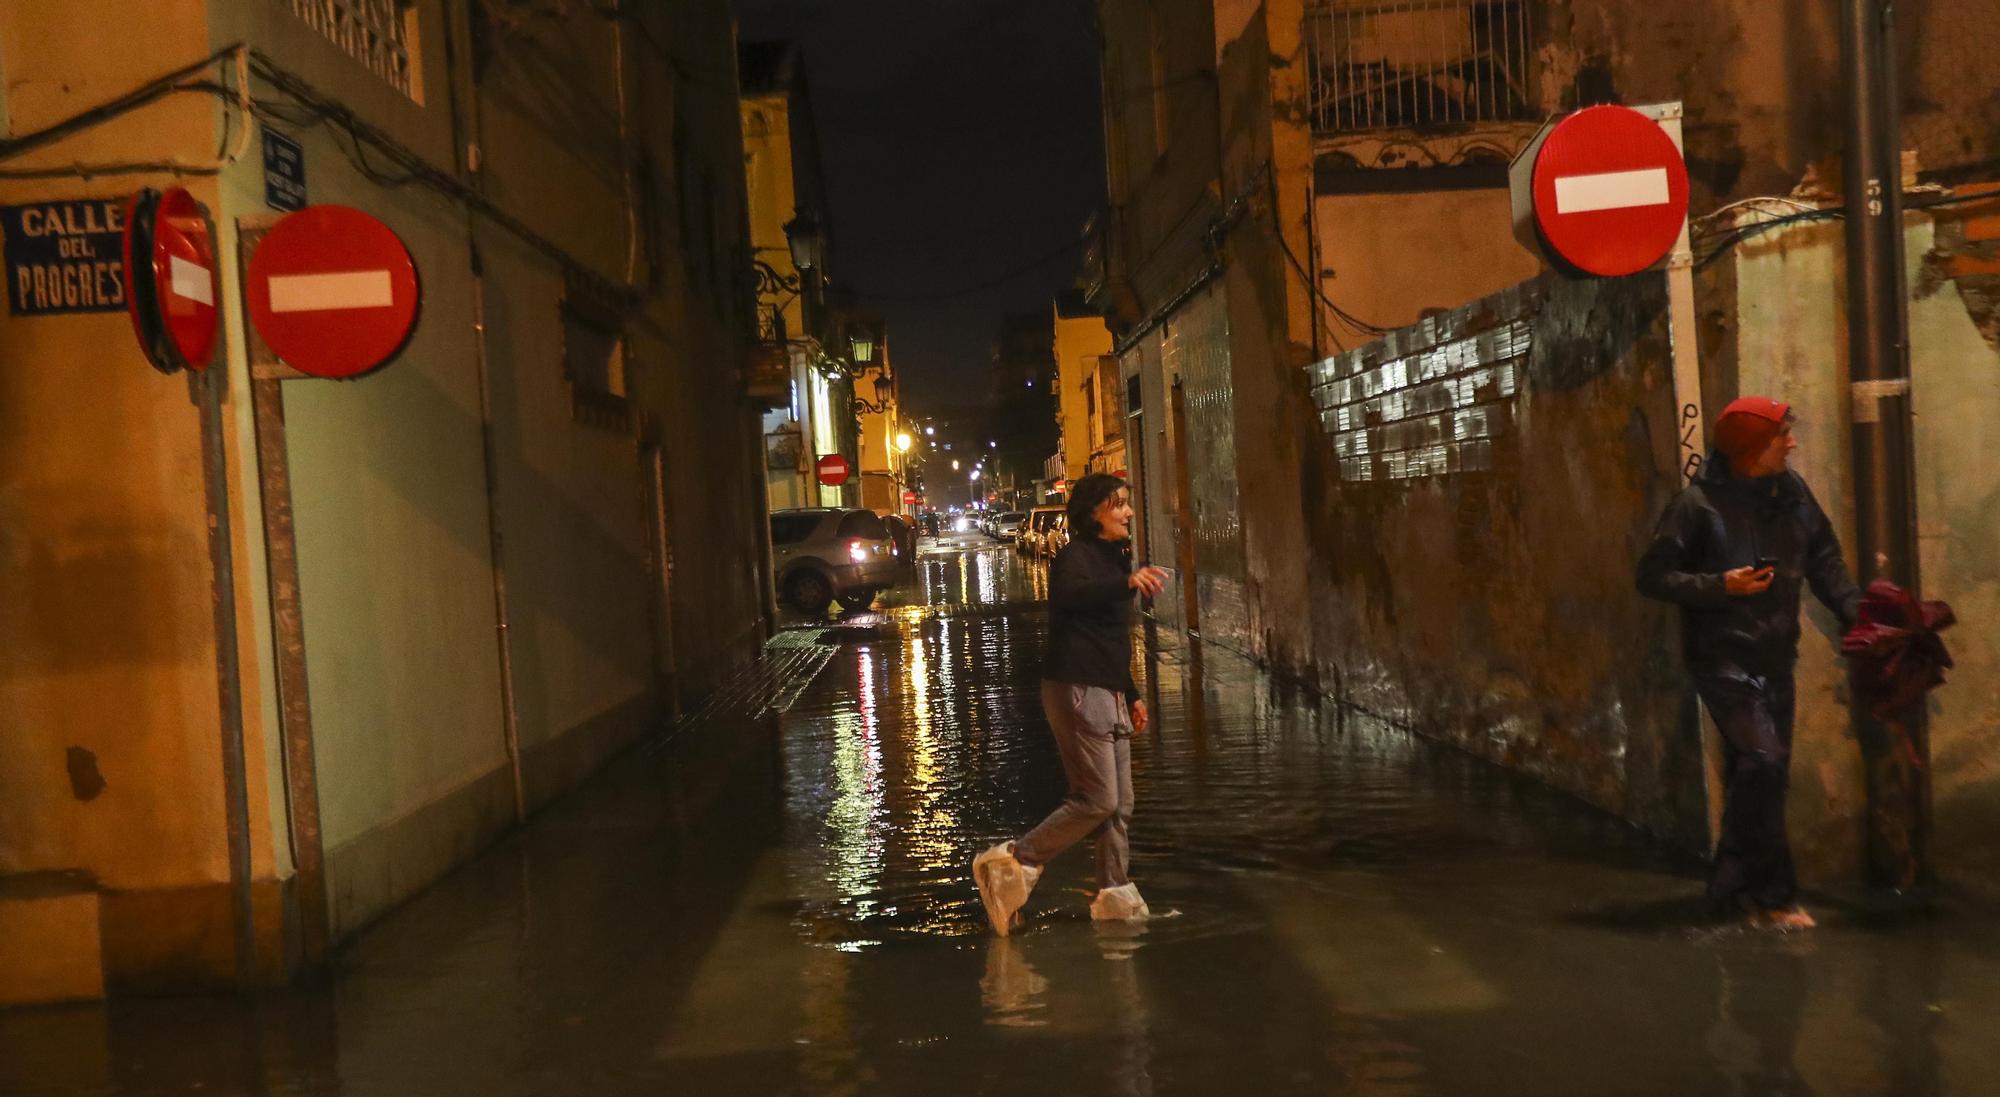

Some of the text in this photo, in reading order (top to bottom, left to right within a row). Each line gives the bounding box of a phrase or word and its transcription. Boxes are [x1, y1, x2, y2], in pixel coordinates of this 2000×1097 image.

[22, 204, 123, 237] CALLE
[59, 238, 96, 258] DEL
[18, 263, 124, 309] PROGRES
